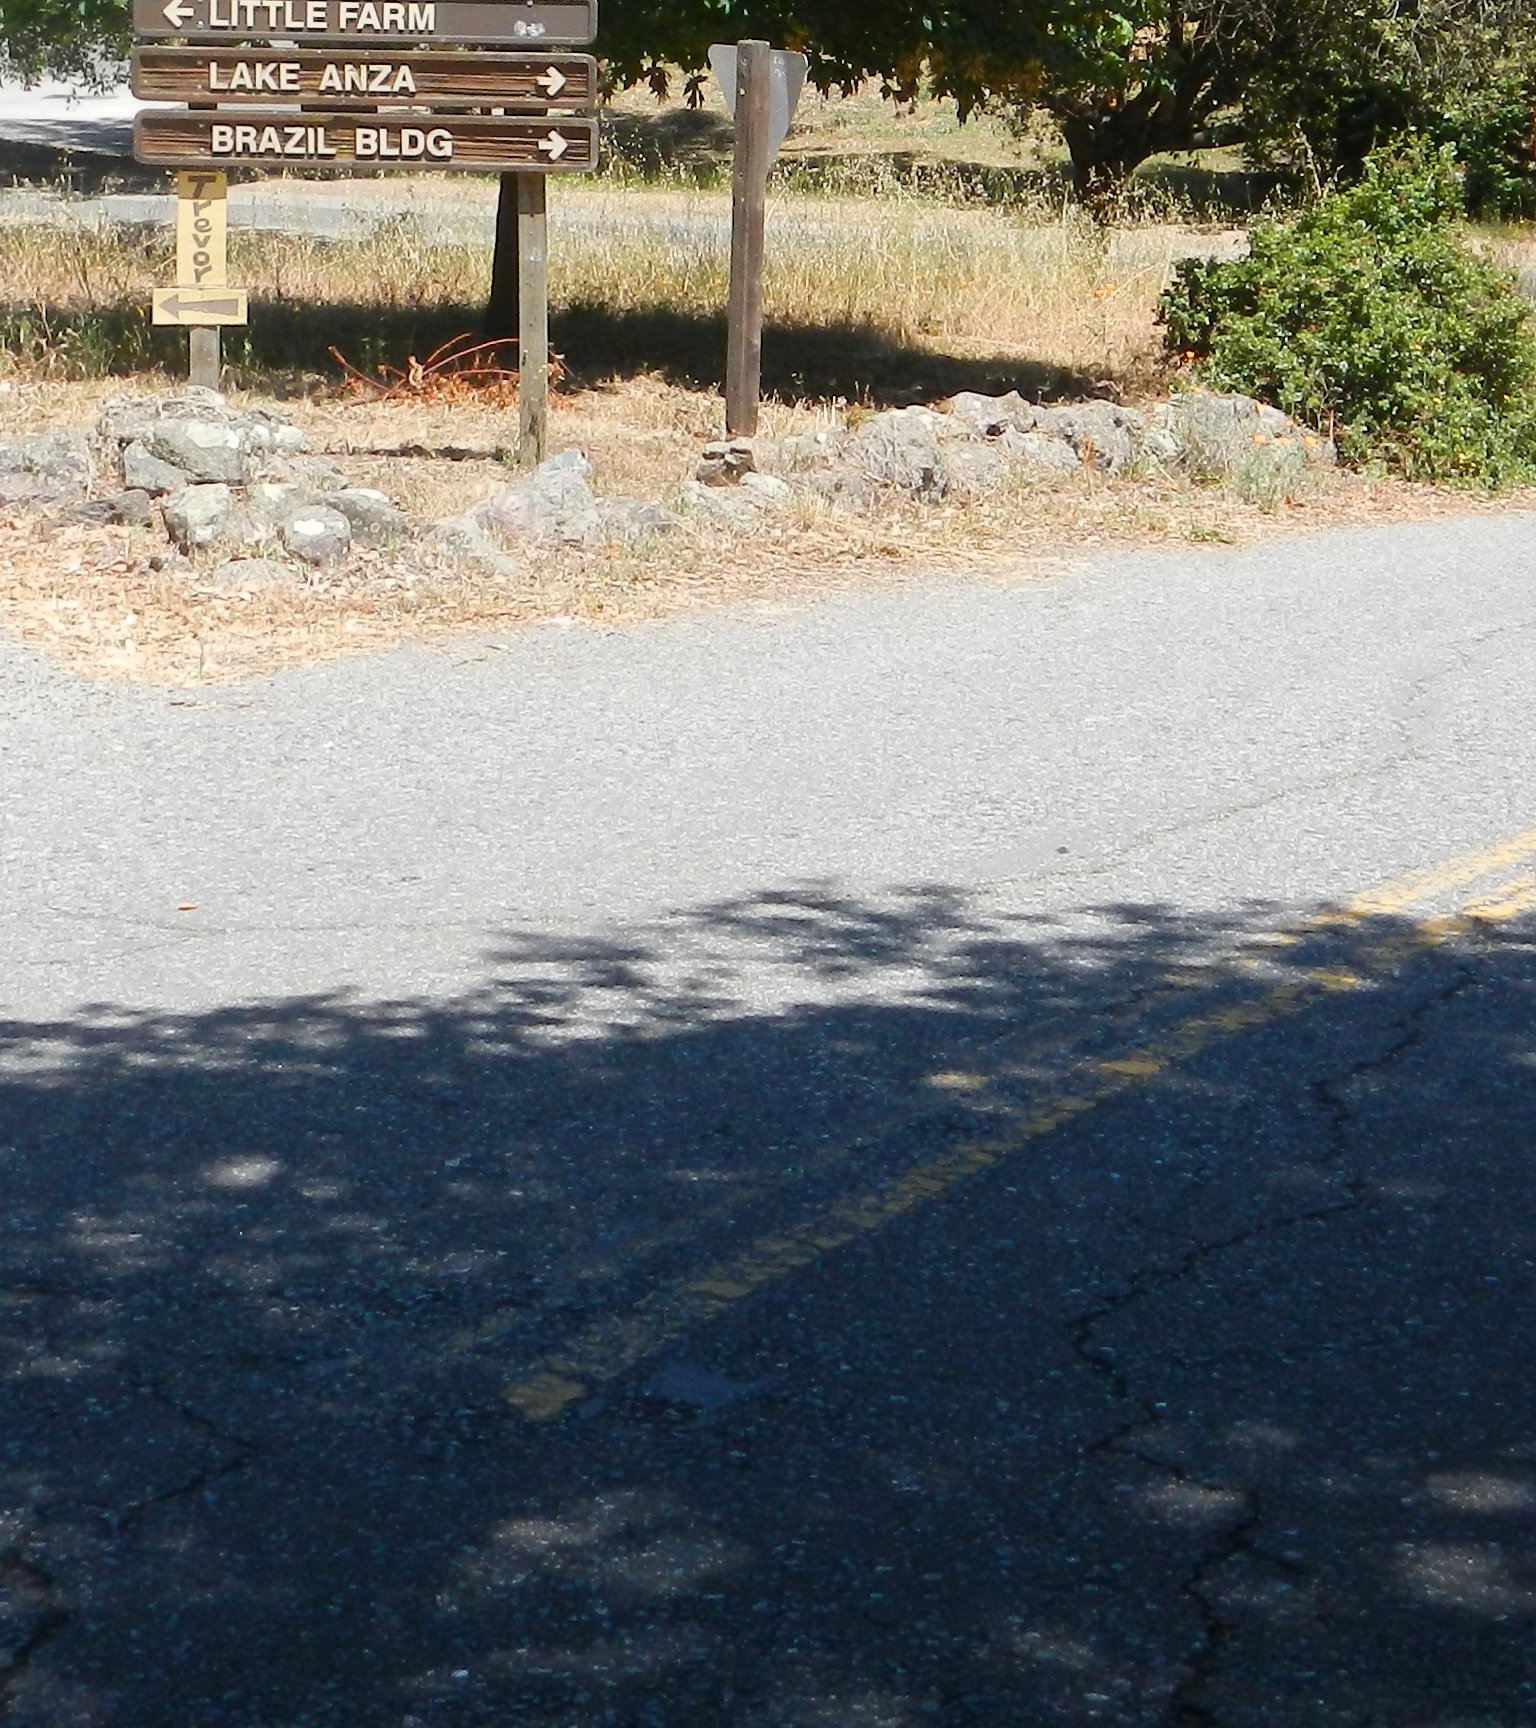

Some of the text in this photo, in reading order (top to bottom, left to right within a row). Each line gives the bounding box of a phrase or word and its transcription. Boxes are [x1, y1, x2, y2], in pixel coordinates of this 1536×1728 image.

[208, 0, 437, 32] LITTLE FARM
[208, 61, 417, 94] LAKE ANZA
[211, 124, 454, 159] BRAZIL BLDG
[187, 175, 218, 283] Trevor
